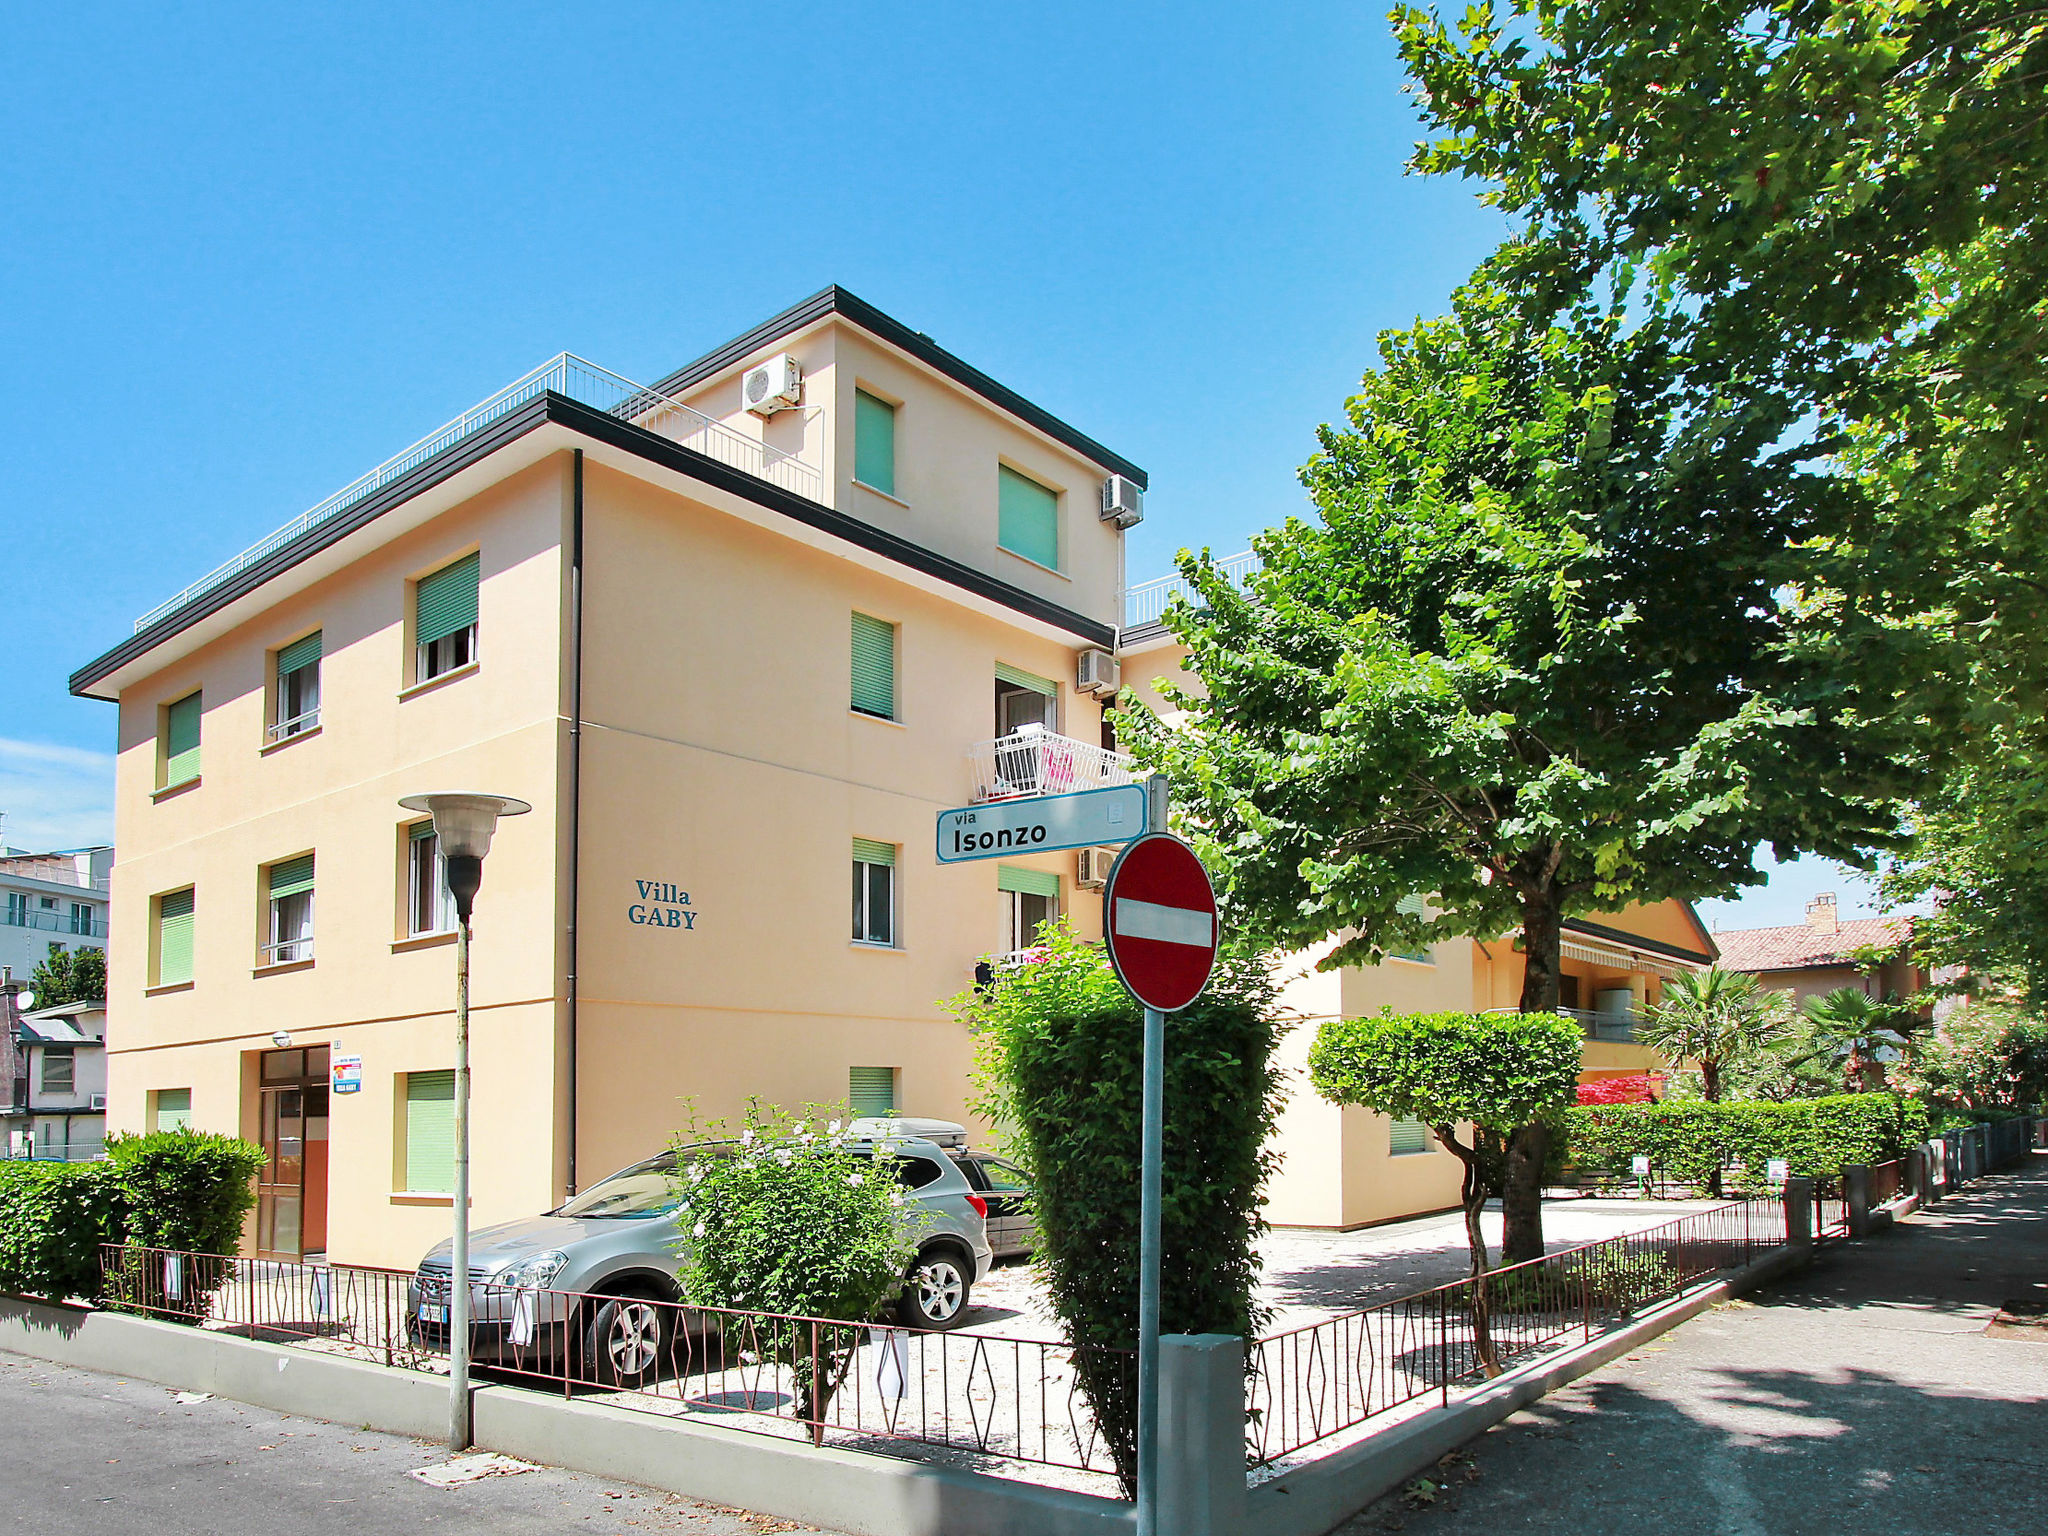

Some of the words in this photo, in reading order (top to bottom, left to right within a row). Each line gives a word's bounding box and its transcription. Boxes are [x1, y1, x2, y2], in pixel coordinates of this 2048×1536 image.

[955, 812, 977, 825] via
[954, 825, 1047, 853] Isonzo
[635, 879, 692, 905] Villa
[628, 904, 698, 930] GABY
